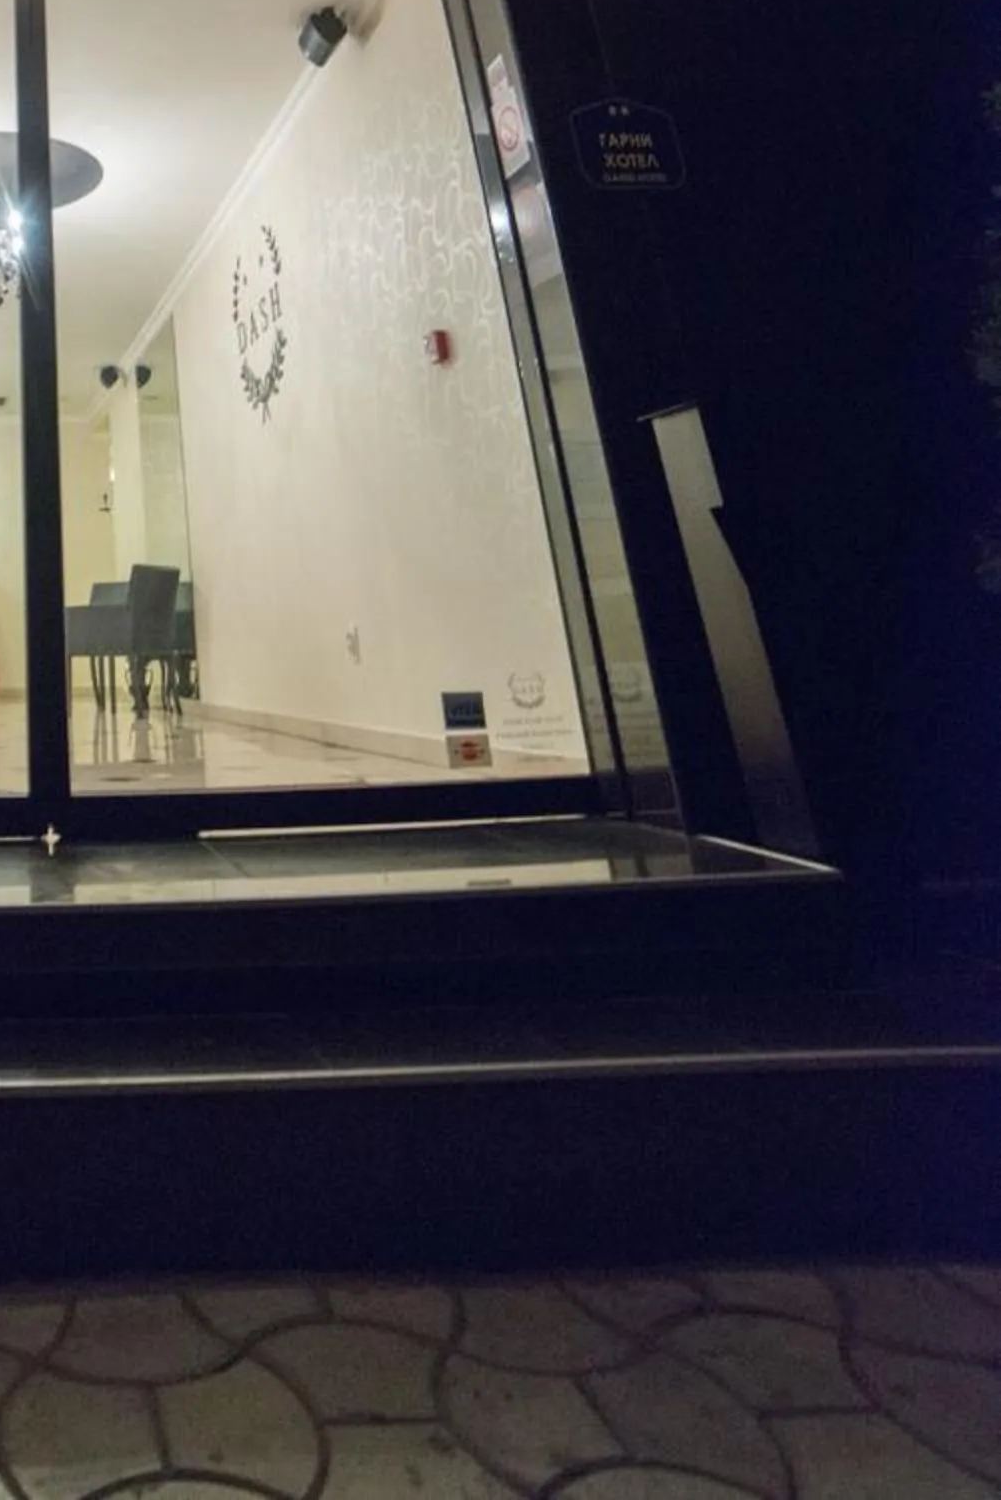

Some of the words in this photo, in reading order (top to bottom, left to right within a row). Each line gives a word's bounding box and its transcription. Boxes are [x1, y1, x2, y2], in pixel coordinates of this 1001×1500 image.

[598, 132, 654, 149] ГАРНИ
[603, 153, 660, 169] ХОТЕЛ
[237, 281, 282, 354] DASH
